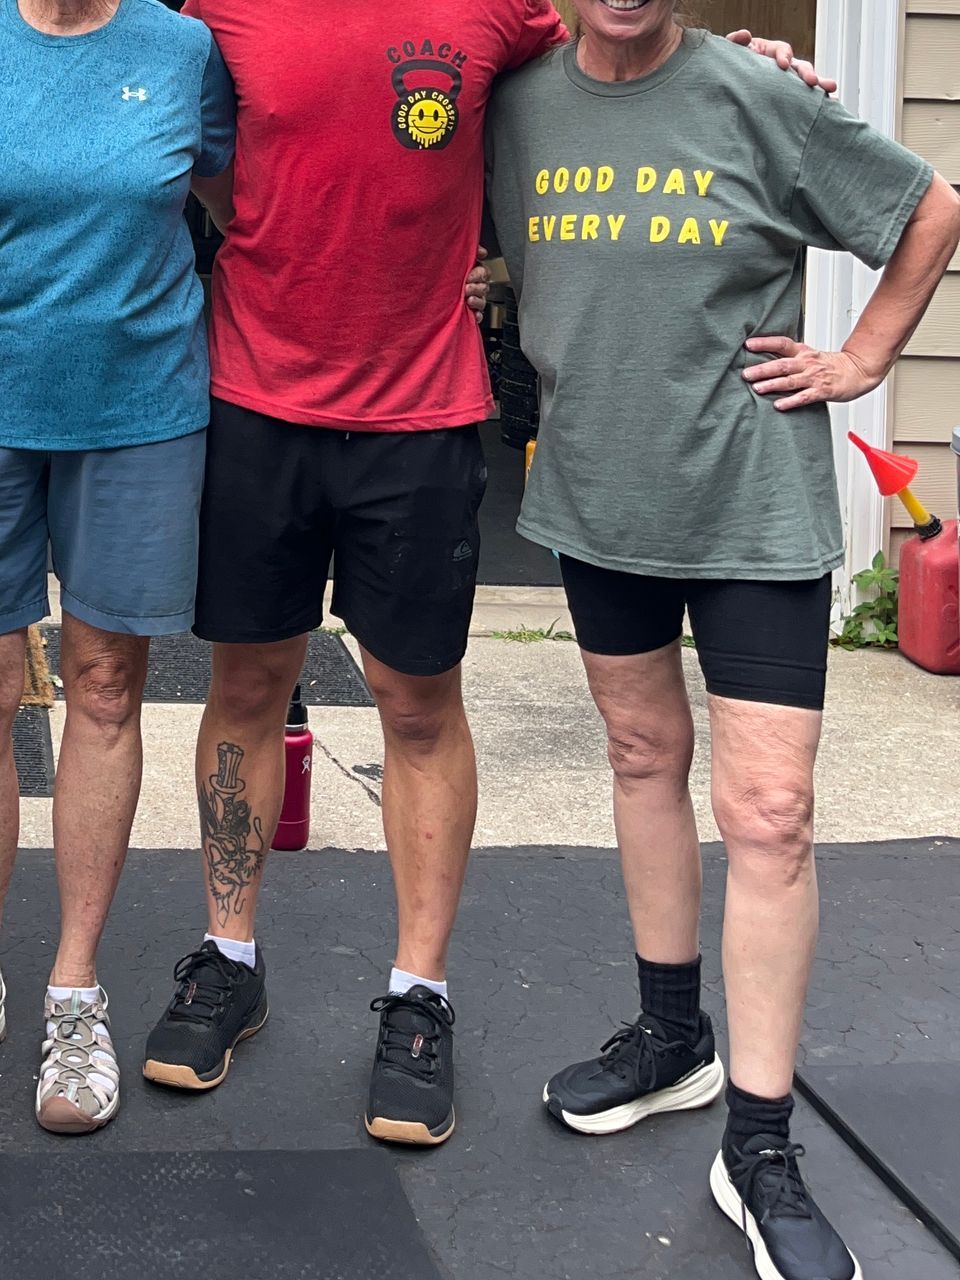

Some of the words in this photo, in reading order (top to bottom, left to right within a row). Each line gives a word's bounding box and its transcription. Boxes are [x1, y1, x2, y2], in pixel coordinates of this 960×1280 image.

[386, 39, 469, 69] COACH
[397, 104, 409, 129] GOOD
[407, 90, 427, 104] DAY
[431, 91, 456, 131] CROSSFIT
[535, 166, 615, 195] GOOD
[636, 166, 715, 197] DAY
[528, 214, 626, 242] EVERY
[649, 216, 729, 246] DAY
